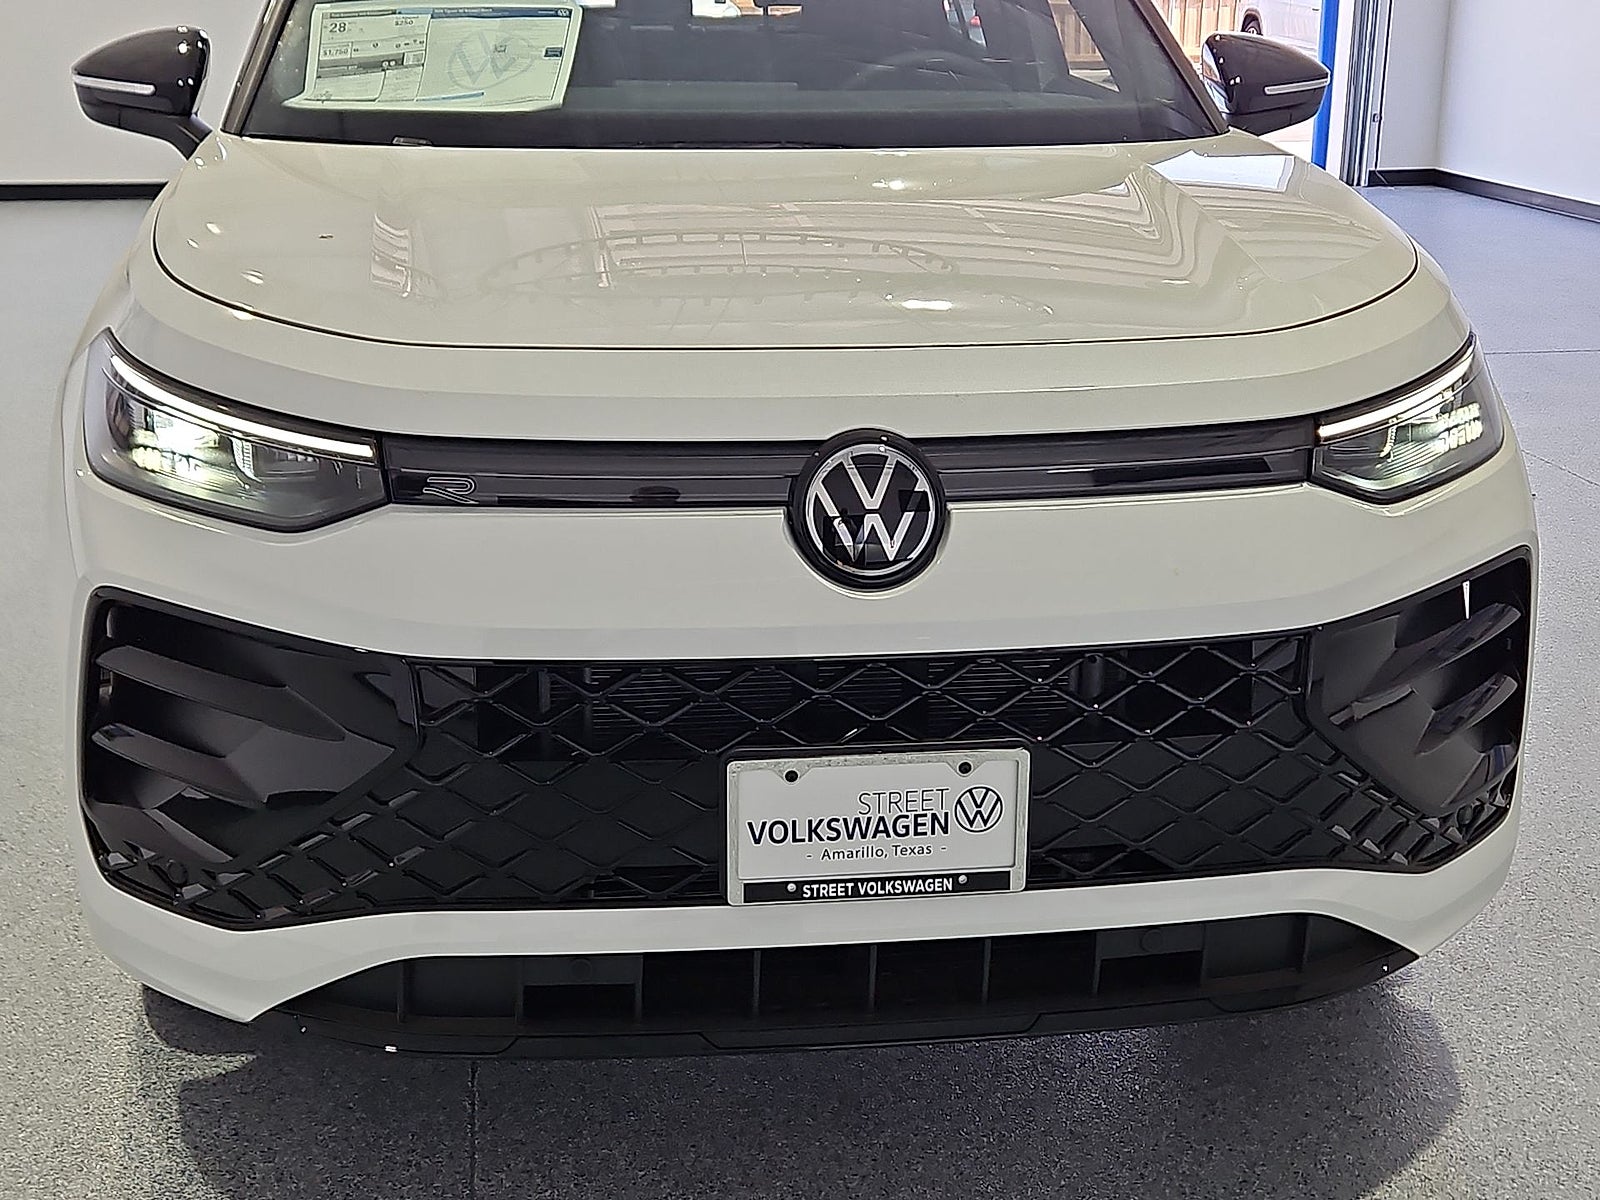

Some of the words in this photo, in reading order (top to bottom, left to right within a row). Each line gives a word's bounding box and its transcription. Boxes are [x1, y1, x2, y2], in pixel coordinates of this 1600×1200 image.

[329, 21, 347, 33] 28
[857, 787, 950, 815] STREET
[747, 811, 949, 845] VOLKSWAGEN
[821, 846, 888, 861] Amarillo,
[892, 843, 933, 857] Texas
[802, 881, 853, 898] STREET
[858, 878, 953, 895] VOLKSWAGEN
